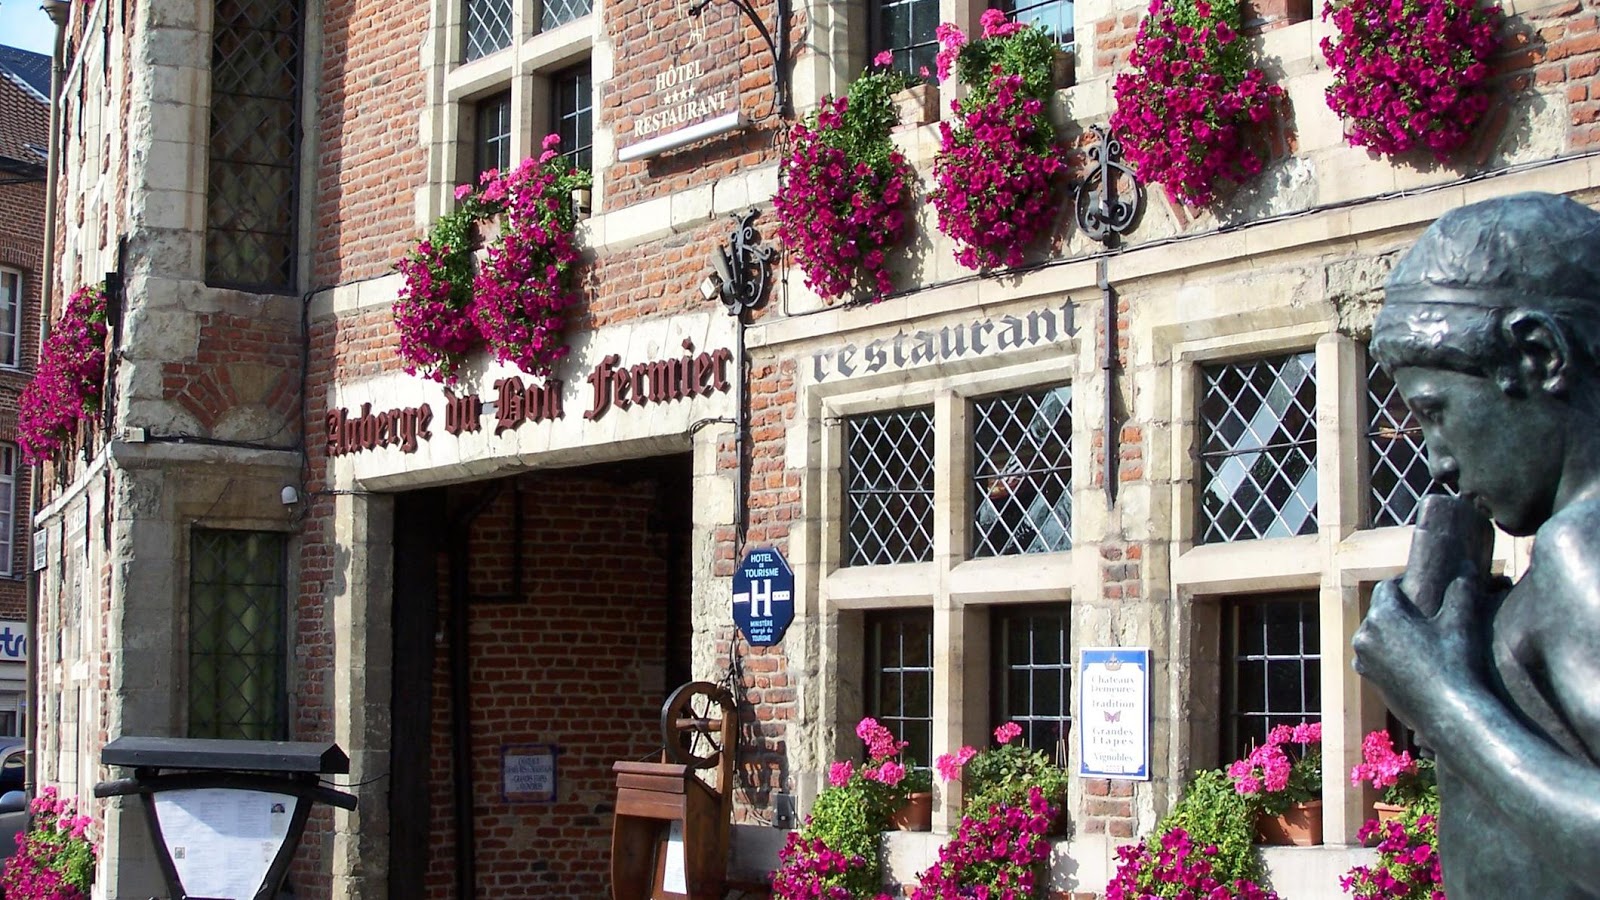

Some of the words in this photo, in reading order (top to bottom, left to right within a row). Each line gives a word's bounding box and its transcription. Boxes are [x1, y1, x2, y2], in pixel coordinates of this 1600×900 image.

[656, 60, 705, 92] HÔTEL
[634, 91, 728, 137] RESTAURANT
[812, 296, 1082, 383] restaurant
[325, 402, 433, 457] Auberge
[444, 387, 483, 436] du
[494, 376, 566, 439] Bon
[584, 337, 734, 421] Fermier
[745, 568, 779, 577] TOURISME
[750, 553, 773, 563] HOTEL
[751, 579, 772, 617] H
[1092, 699, 1135, 708] Tradition
[1092, 727, 1134, 736] Grandes
